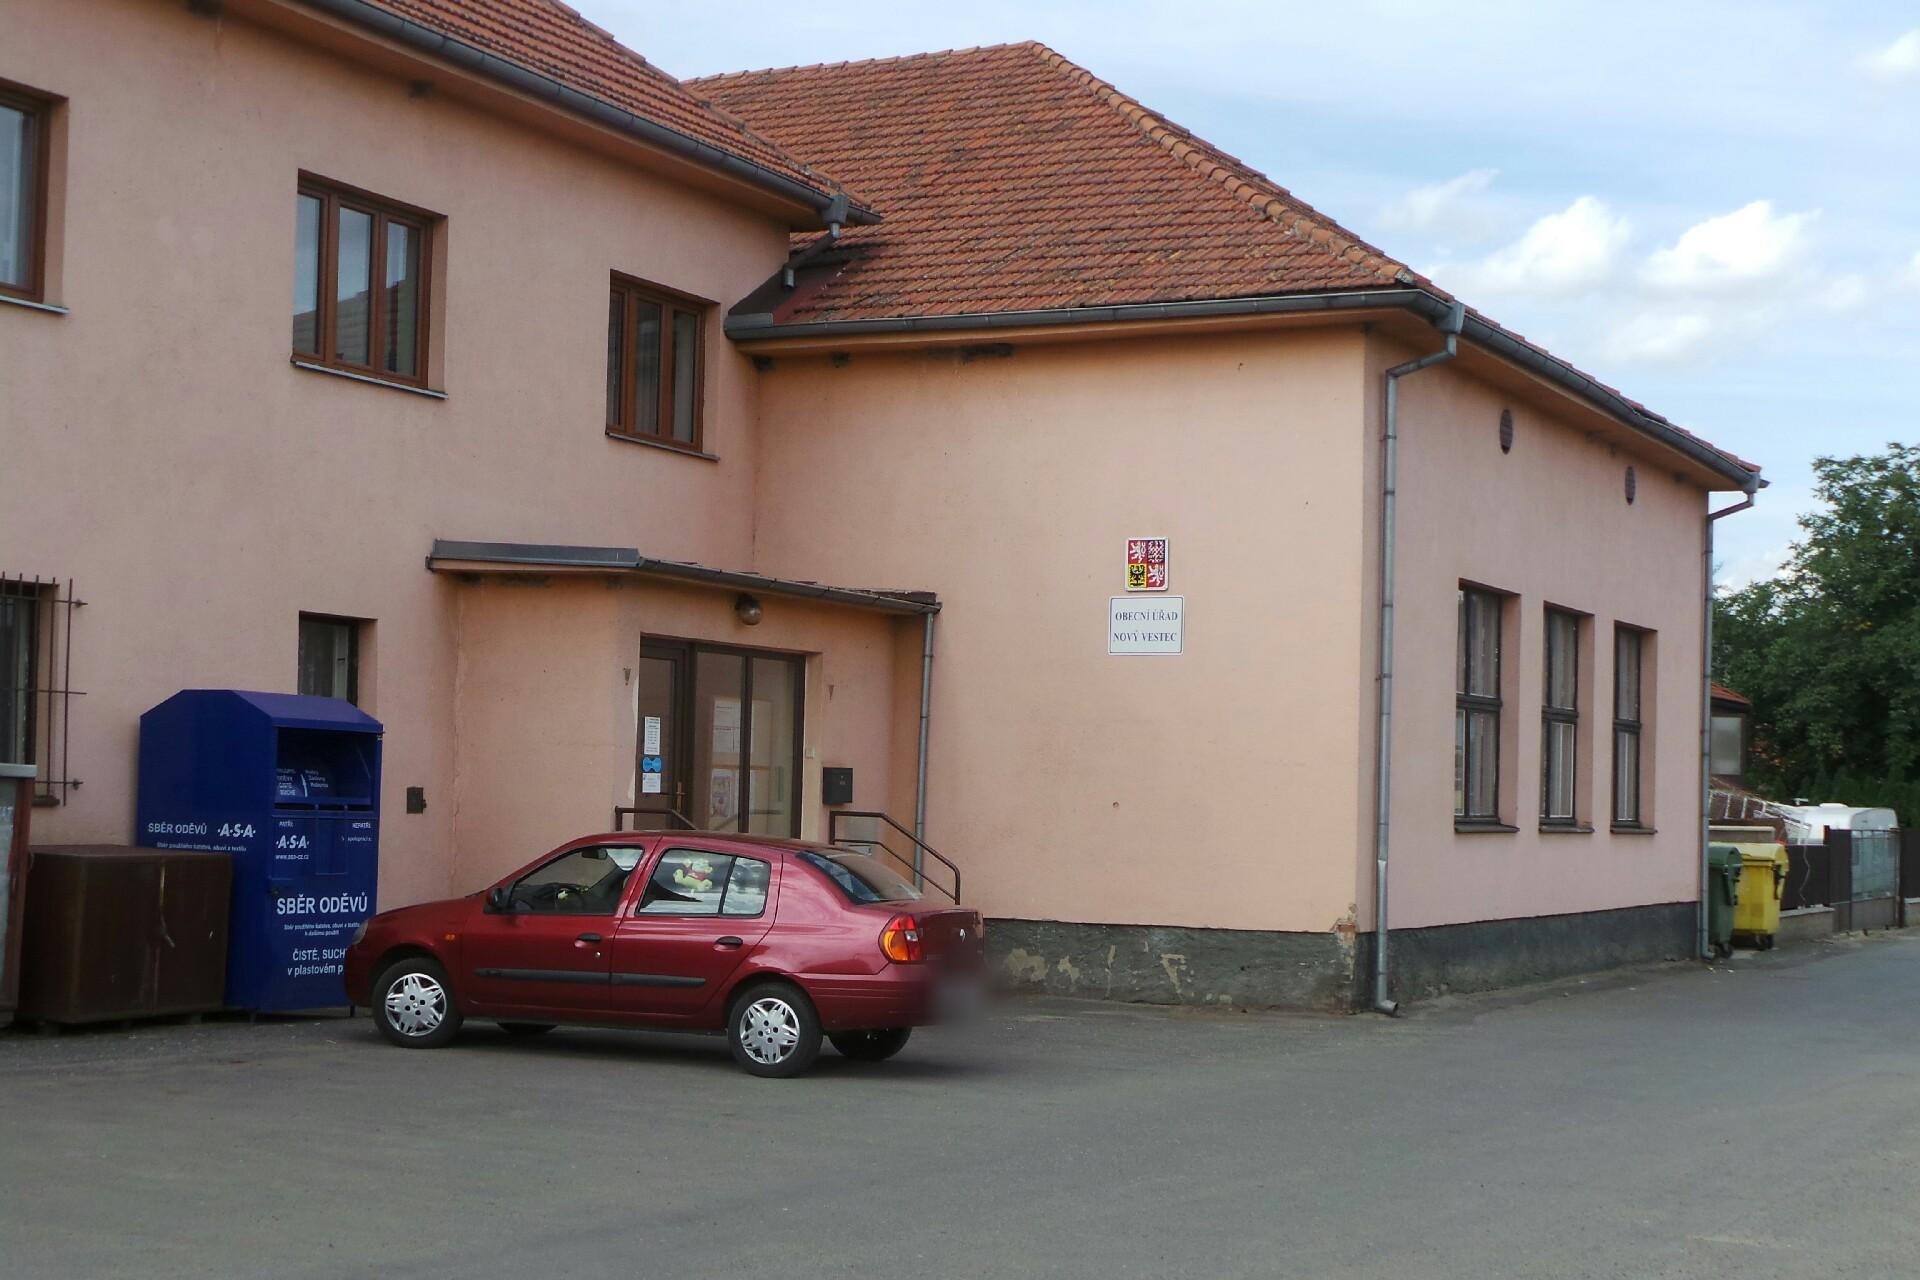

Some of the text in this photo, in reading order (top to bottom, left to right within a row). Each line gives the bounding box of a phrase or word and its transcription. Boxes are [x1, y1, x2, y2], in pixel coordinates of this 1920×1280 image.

[1115, 609, 1178, 621] OBECNÍ ÚŘAD
[1113, 630, 1177, 642] NOVÝ VESTEC
[148, 822, 207, 835] SBĚR ODĚVŮ
[276, 892, 368, 914] SBĚR ODĚVŮ
[292, 947, 347, 961] ČISTÉ, SUCH
[287, 967, 293, 976] v
[294, 962, 336, 978] plastovém
